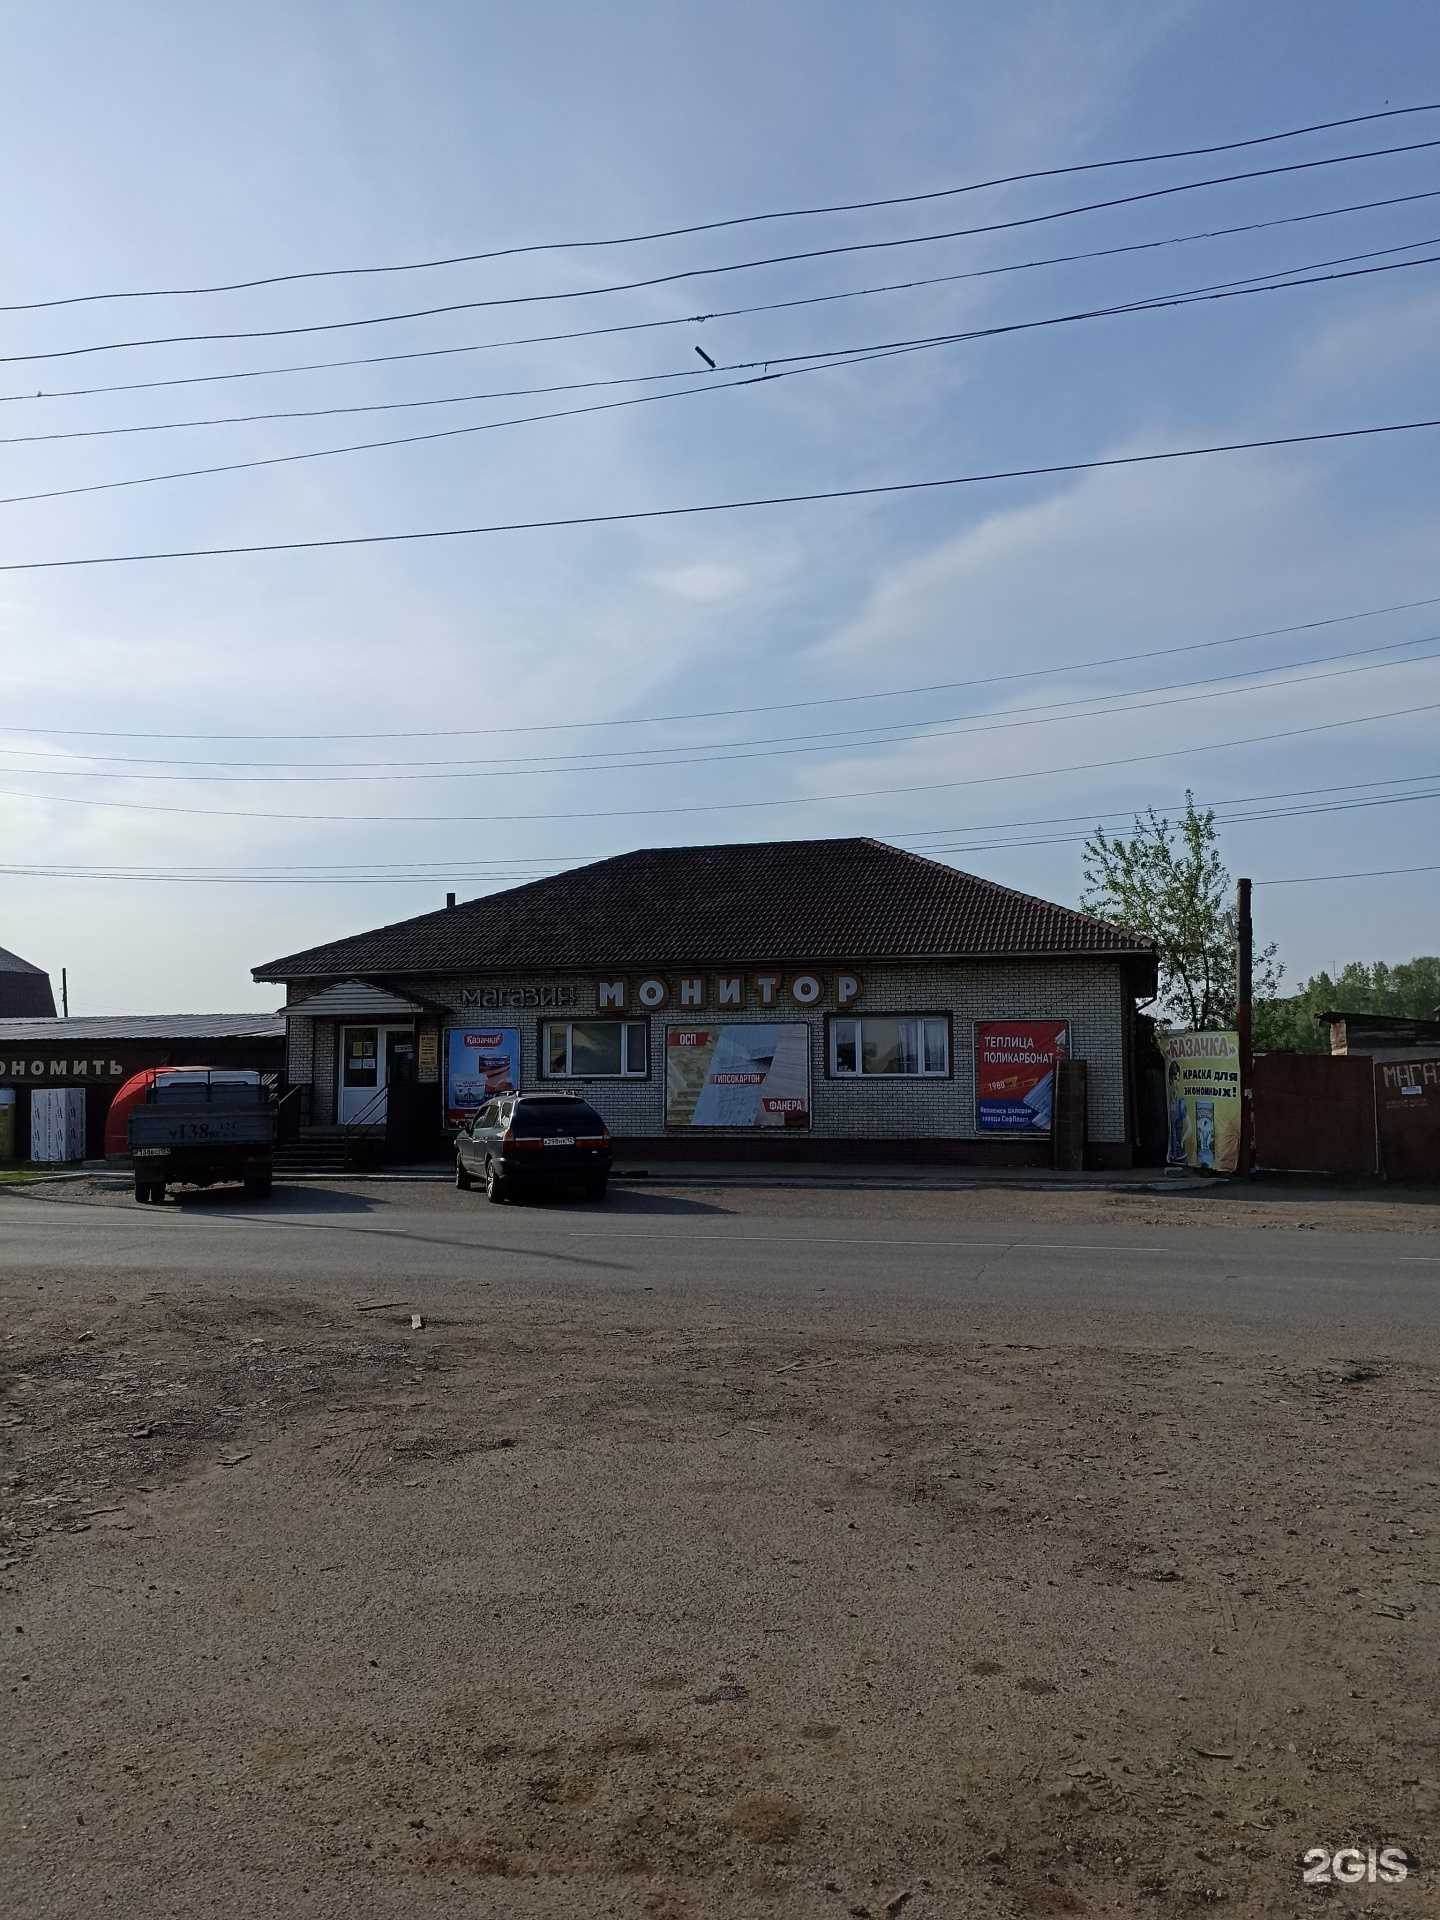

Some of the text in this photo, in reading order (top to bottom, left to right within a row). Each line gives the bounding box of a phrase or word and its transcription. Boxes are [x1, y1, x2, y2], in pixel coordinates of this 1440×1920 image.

[462, 984, 577, 1007] магазин
[600, 976, 858, 1007] МОНИТОР
[680, 1033, 697, 1045] ОСП
[984, 1036, 1035, 1049] ТЕПЛИЦА
[984, 1052, 1054, 1064] ПОЛИКАРБОНАТ
[713, 1074, 760, 1084] ГИПСОКАРТОН
[1183, 1069, 1212, 1080] КРАСКА
[1383, 1062, 1440, 1088] МАГА
[769, 1101, 802, 1112] ФАНЕРА
